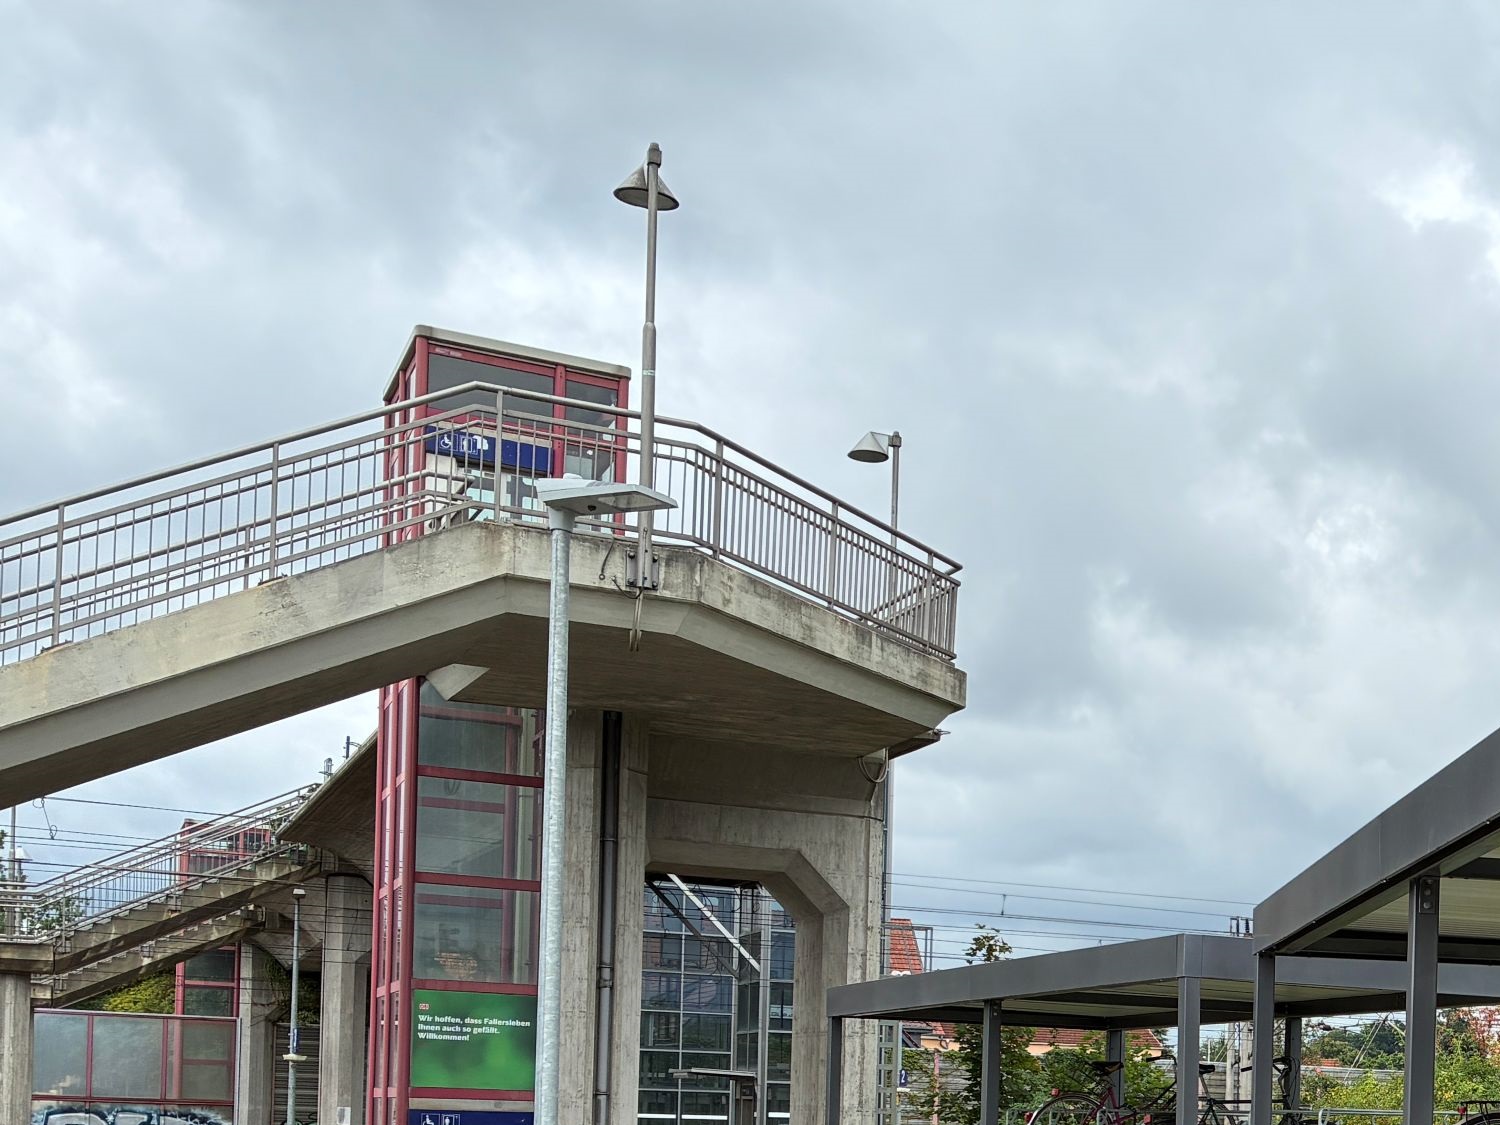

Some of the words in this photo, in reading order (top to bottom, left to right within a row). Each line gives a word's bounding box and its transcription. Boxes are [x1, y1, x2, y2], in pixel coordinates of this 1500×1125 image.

[418, 1014, 433, 1022] Wir
[434, 1015, 463, 1024] hoffen,
[464, 1017, 482, 1025] dass
[483, 1018, 531, 1027] Fallersleben
[418, 1023, 441, 1031] Ihnen
[442, 1024, 461, 1033] auch
[472, 1026, 500, 1035] gefällt.
[418, 1032, 470, 1041] Willkommen!
